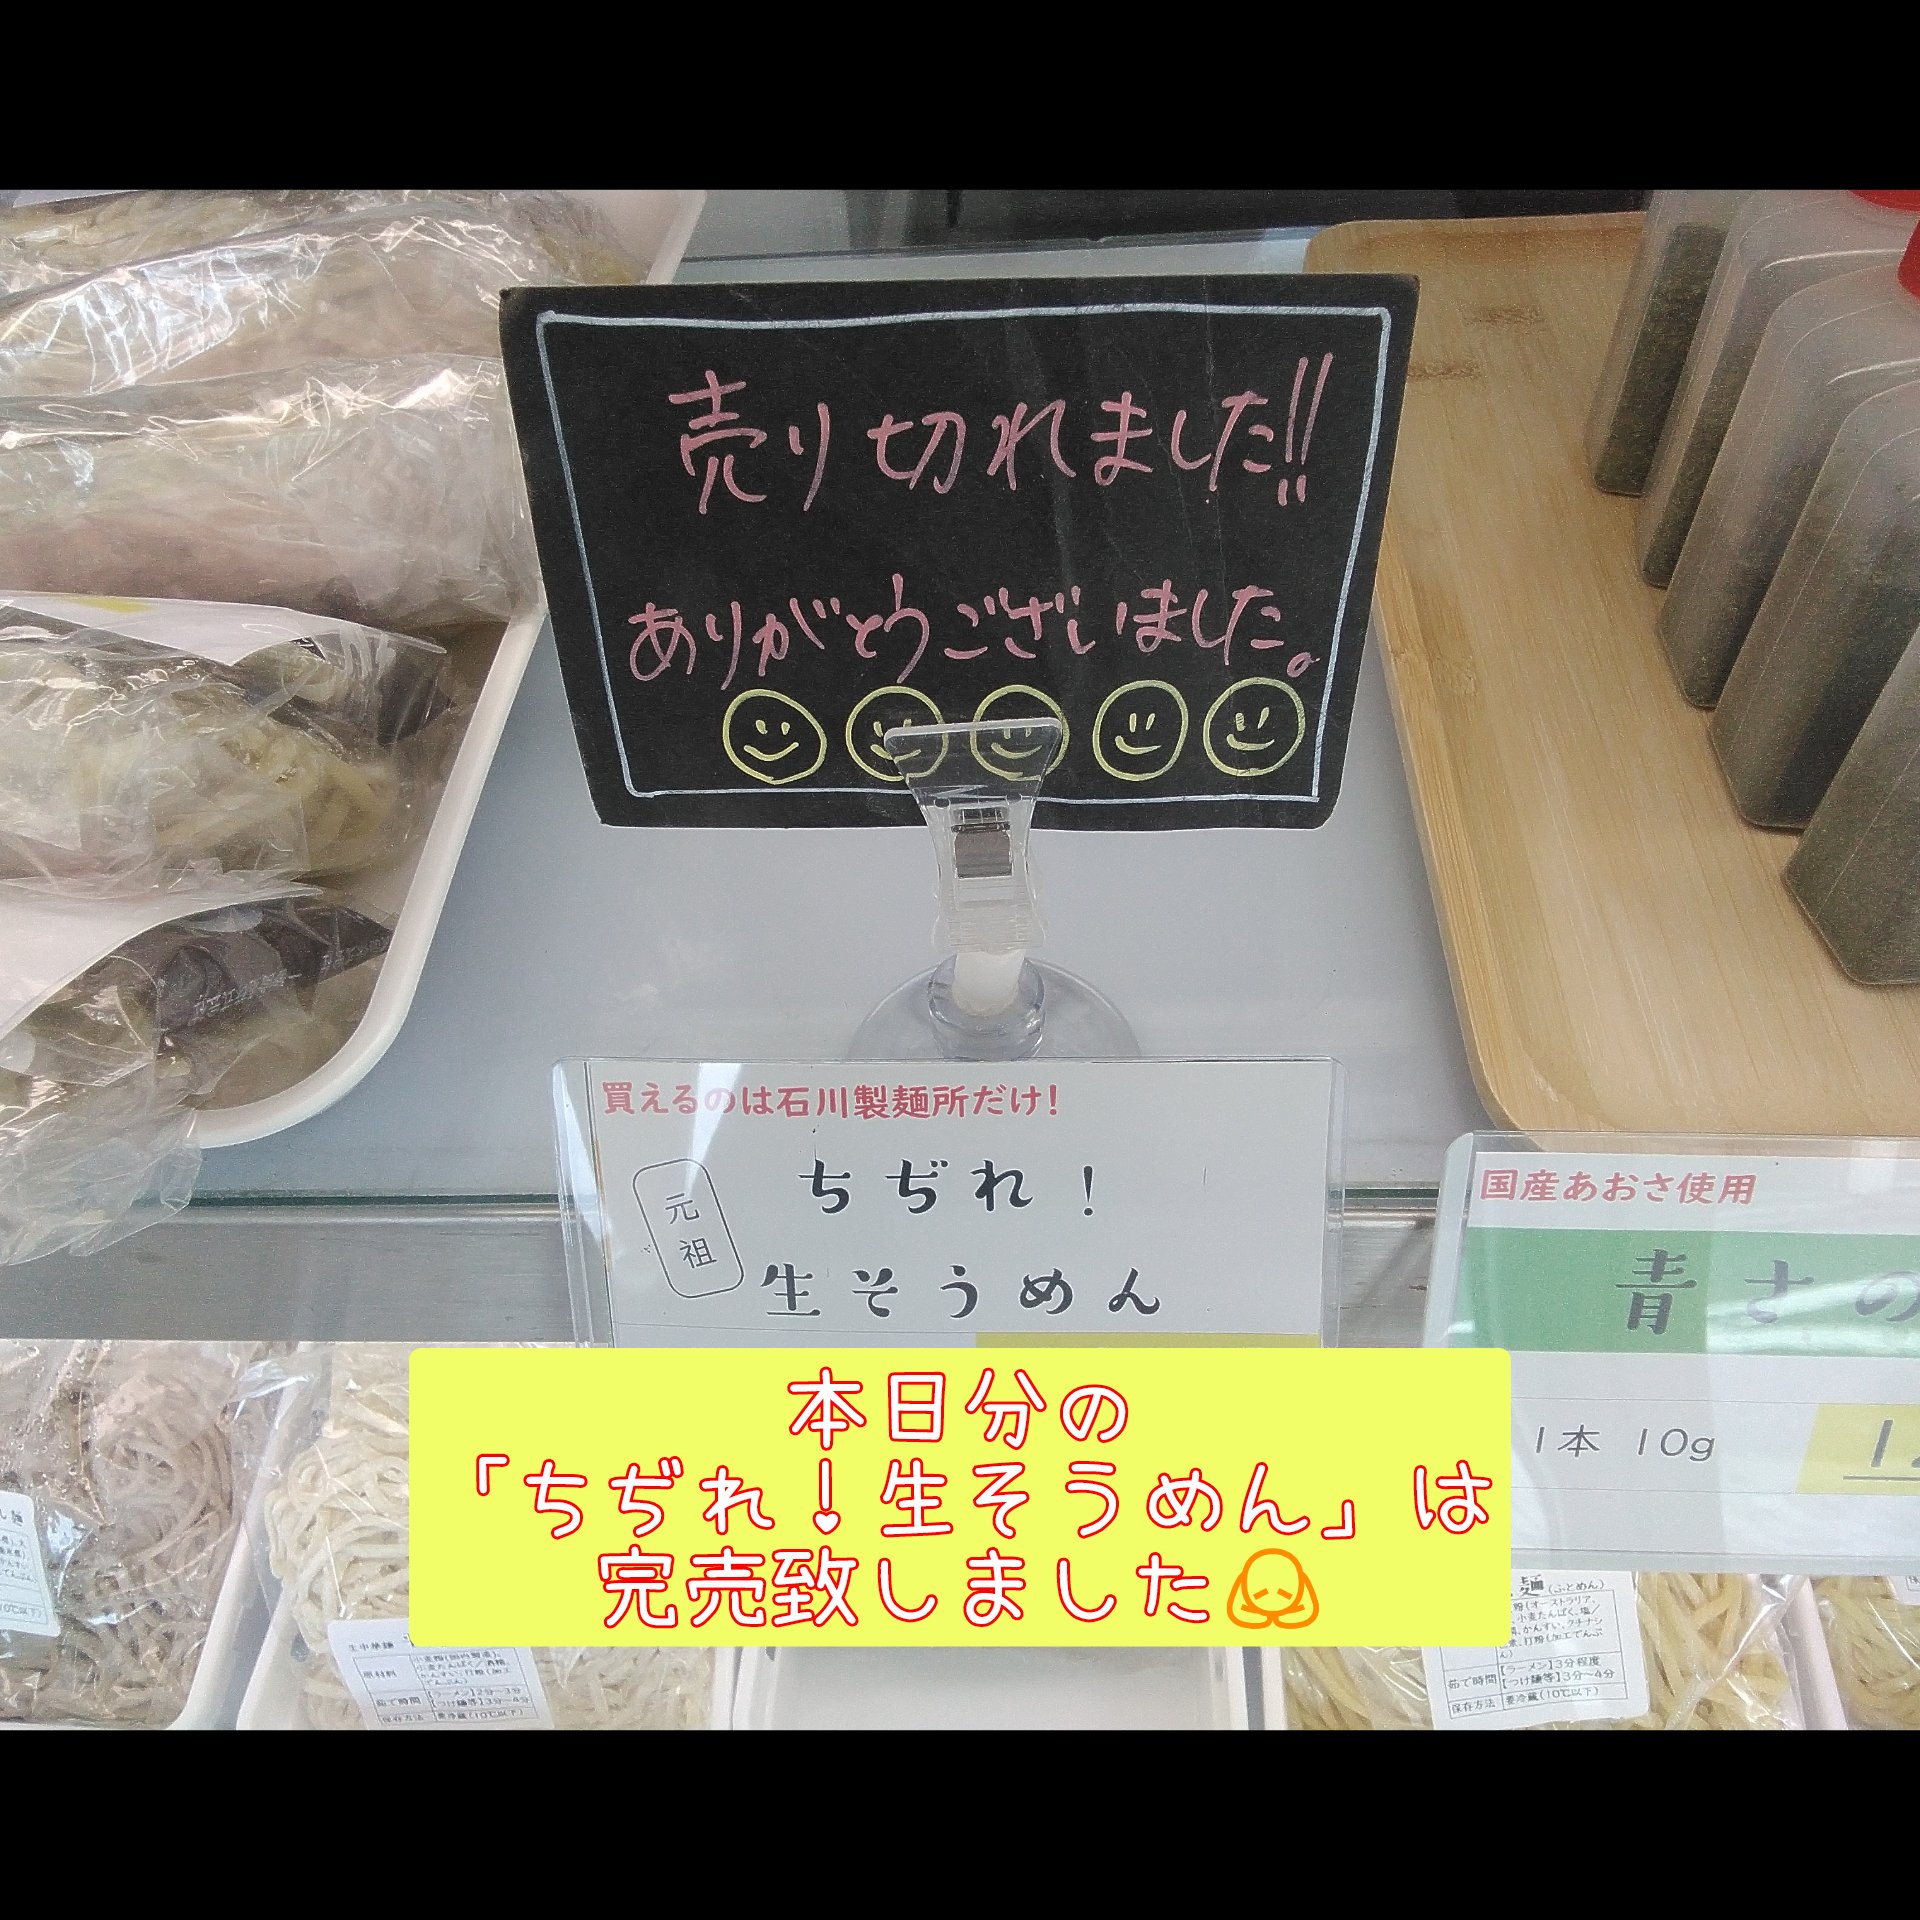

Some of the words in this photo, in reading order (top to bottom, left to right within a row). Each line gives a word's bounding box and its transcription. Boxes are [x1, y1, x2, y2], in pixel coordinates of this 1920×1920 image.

[668, 354, 1334, 514] 売り切れました!!
[628, 574, 1322, 690] ありがとうございました。
[601, 1081, 1058, 1120] 買えるのは石川製麺所だけ!
[798, 1158, 1094, 1217] ちぢれ!
[1479, 1168, 1757, 1205] 国産あおさ使用
[664, 1192, 717, 1269] 元祖
[760, 1263, 1161, 1319] 生そうめん
[1535, 1424, 1601, 1458] 1本
[1638, 1428, 1716, 1462] 10g
[1511, 1574, 1545, 1597] 麺
[1511, 1595, 1597, 1614] 粉(オーストラリア、
[1447, 1673, 1498, 1690] 茹で時間
